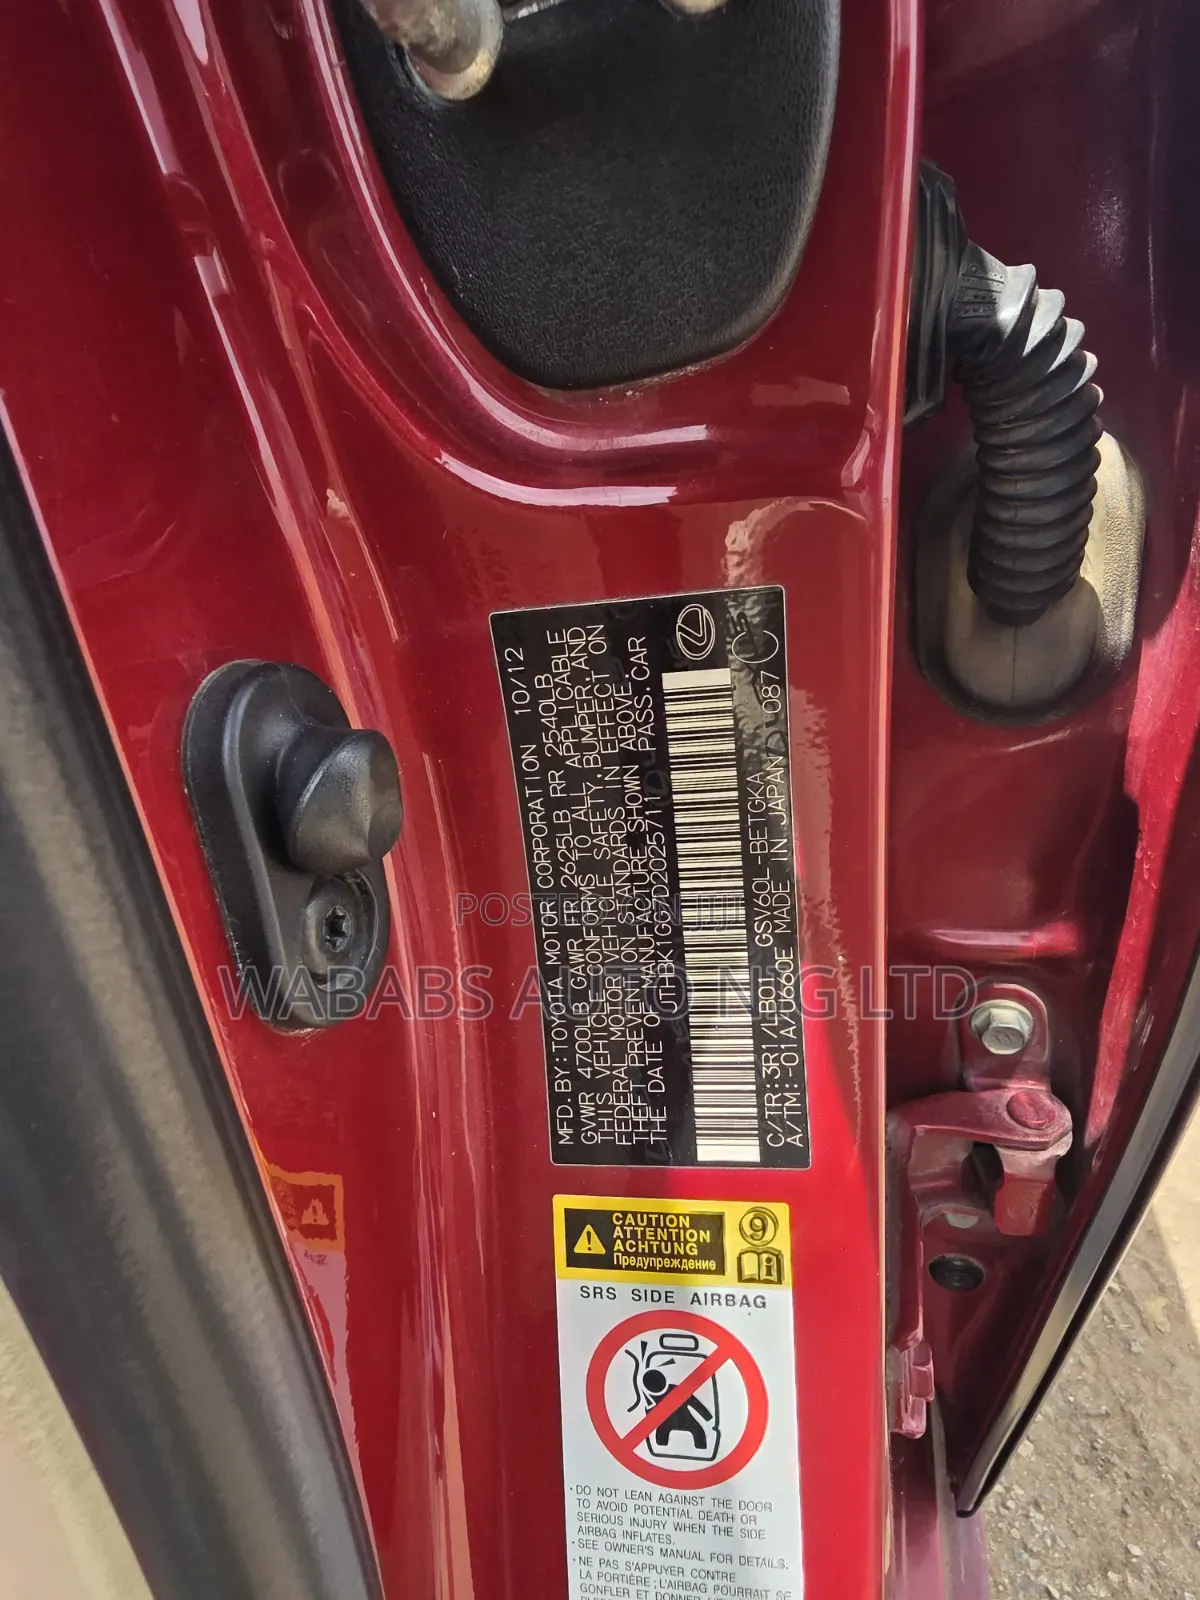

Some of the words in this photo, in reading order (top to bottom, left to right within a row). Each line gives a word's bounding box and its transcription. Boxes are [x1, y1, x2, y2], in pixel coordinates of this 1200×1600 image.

[586, 624, 607, 655] ON
[505, 647, 531, 715] 10/12
[547, 629, 583, 768] APPLICABLE
[761, 670, 781, 714] 087
[535, 673, 562, 757] 2540LB
[592, 670, 619, 754] EFFECT
[614, 673, 637, 751] ABOVE.
[548, 770, 566, 796] RR
[570, 783, 588, 821] ALL
[603, 766, 621, 788] IN
[623, 765, 646, 832] SHOWN
[767, 755, 786, 825] JAPAN
[520, 744, 553, 889] CORPORATION
[553, 810, 577, 887] 2625LB
[574, 835, 592, 860] TO
[609, 806, 635, 924] STANDARDS
[746, 772, 772, 947] GSV60L-BETGKA
[771, 839, 788, 860] IN
[564, 901, 580, 926] FR
[579, 874, 601, 975] CONFORMS
[596, 874, 617, 961] VEHICLE
[629, 846, 656, 989] MANUFACTURE
[644, 796, 677, 1013] JTHBK1GG7D2025711
[773, 880, 790, 933] MADE
[540, 901, 562, 965] MOTOR
[567, 939, 586, 989] GAWR
[606, 976, 624, 1041] MOTOR
[621, 937, 644, 1067] PREVENTION
[642, 1005, 660, 1027] OF
[573, 1002, 593, 1079] 4700LB
[588, 989, 609, 1079] VEHICLE
[645, 1041, 665, 1092] DATE
[579, 1092, 596, 1144] GVWR
[597, 1092, 614, 1144] THIS
[611, 1054, 631, 1144] FEDERAL
[631, 1081, 649, 1144] THEFT
[649, 1106, 666, 1144] THE
[612, 1213, 690, 1228] CAUTION
[613, 1226, 711, 1243] ATTENTION
[613, 1240, 698, 1255] ACHTUNG
[613, 1253, 716, 1270] Предупреждение
[580, 1285, 617, 1300] SRS
[631, 1288, 675, 1304] SIDE
[690, 1291, 767, 1309] AIRBAG
[576, 1485, 591, 1495] DO
[597, 1487, 619, 1498] NOT
[624, 1489, 652, 1502] LEAN
[658, 1493, 705, 1507] AGAINST
[711, 1498, 733, 1510] THE
[738, 1501, 772, 1512] DOOR
[577, 1498, 591, 1508] TO
[596, 1500, 628, 1513] AVOID
[634, 1504, 693, 1519] POTENTIAL
[699, 1510, 734, 1523] DEATH
[740, 1514, 757, 1525] OR
[577, 1512, 624, 1525] SERIOUS
[629, 1517, 667, 1530] INJURY
[673, 1522, 706, 1535] WHEN
[712, 1525, 734, 1537] THE
[740, 1529, 766, 1540] SIDE
[578, 1525, 617, 1539] AIRBAG
[622, 1529, 675, 1545] INFLATES.
[578, 1539, 599, 1550] SEE
[605, 1542, 654, 1556] OWNER'S
[660, 1548, 705, 1562] MANUAL
[710, 1553, 733, 1565] FOR
[739, 1556, 789, 1570] DETAILS.
[579, 1556, 593, 1566] NE
[600, 1558, 619, 1570] PAS
[625, 1561, 685, 1577] S'APPUYER
[690, 1568, 736, 1583] CONTRE
[580, 1570, 593, 1580] LA
[713, 1584, 771, 1600] POURRAIT
[580, 1583, 630, 1599] GONFLER
[636, 1589, 649, 1600] ET
